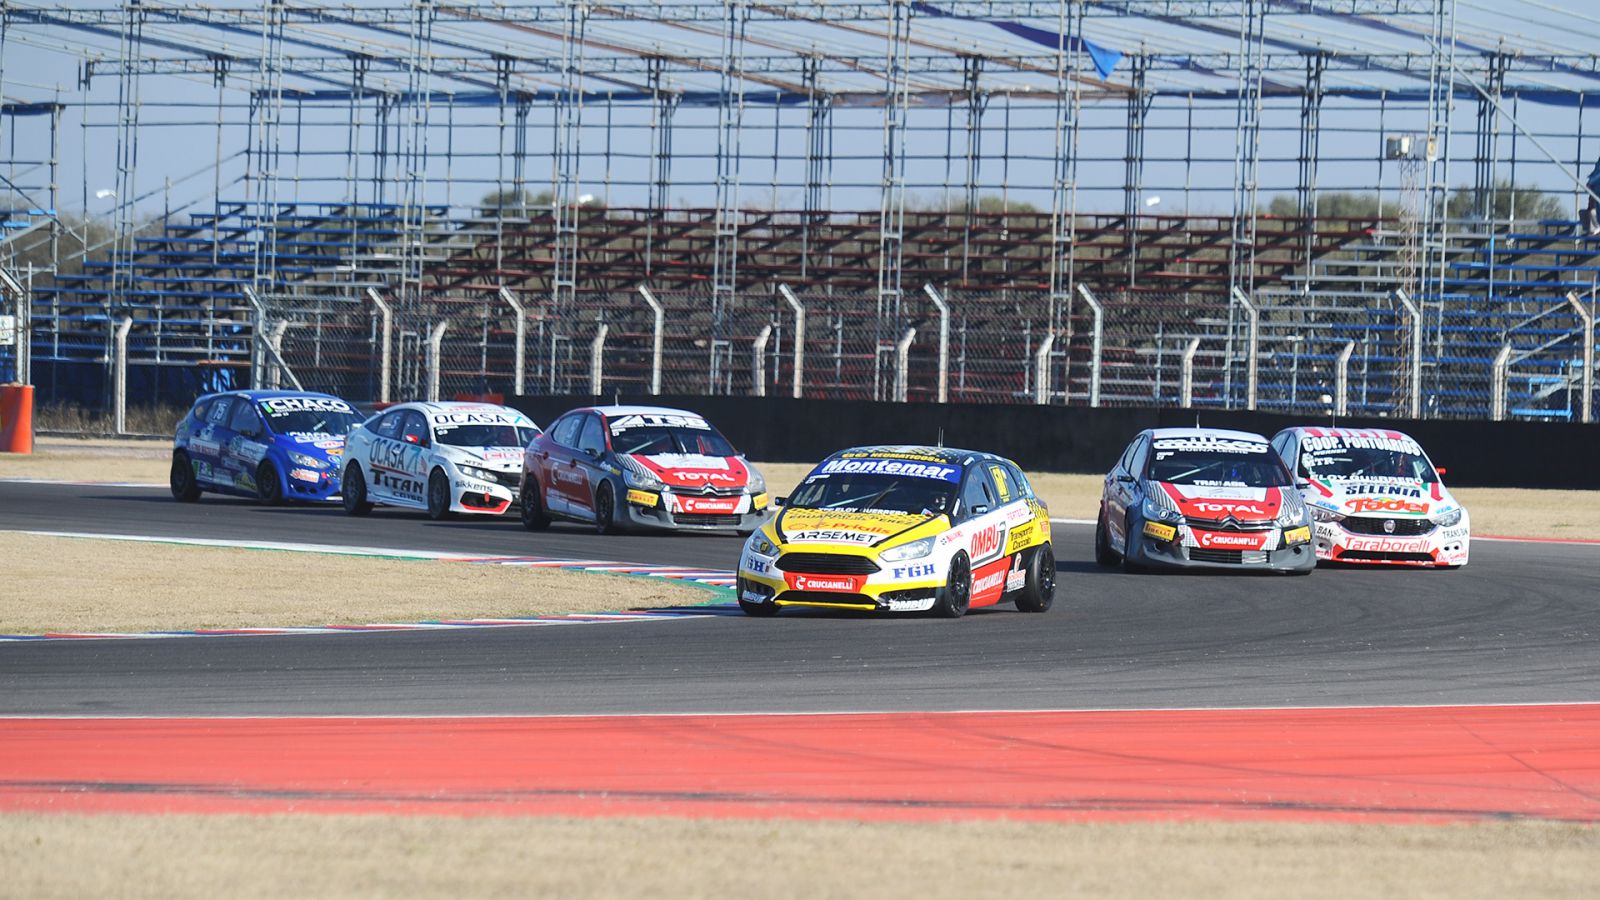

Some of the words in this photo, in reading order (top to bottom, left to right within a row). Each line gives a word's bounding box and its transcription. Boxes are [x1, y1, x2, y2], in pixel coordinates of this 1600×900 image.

[268, 399, 350, 412] CHACO
[434, 413, 510, 425] OCASA
[1302, 436, 1342, 452] COOP.
[1343, 436, 1421, 457] PORTUARIOS
[369, 437, 407, 470] OCASA
[821, 458, 955, 478] Montemar
[672, 472, 736, 482] TOTAL
[455, 480, 494, 493] sikkens
[1345, 485, 1421, 498] SELENIA
[1193, 502, 1265, 514] TOTAL
[792, 530, 878, 543] ARSEMET
[970, 523, 999, 559] OMBU
[1211, 536, 1258, 547] CRUCIANELLI
[1345, 536, 1431, 553] Taraborelli
[892, 563, 936, 579] FGH
[806, 579, 853, 590] CRUCIANELLI
